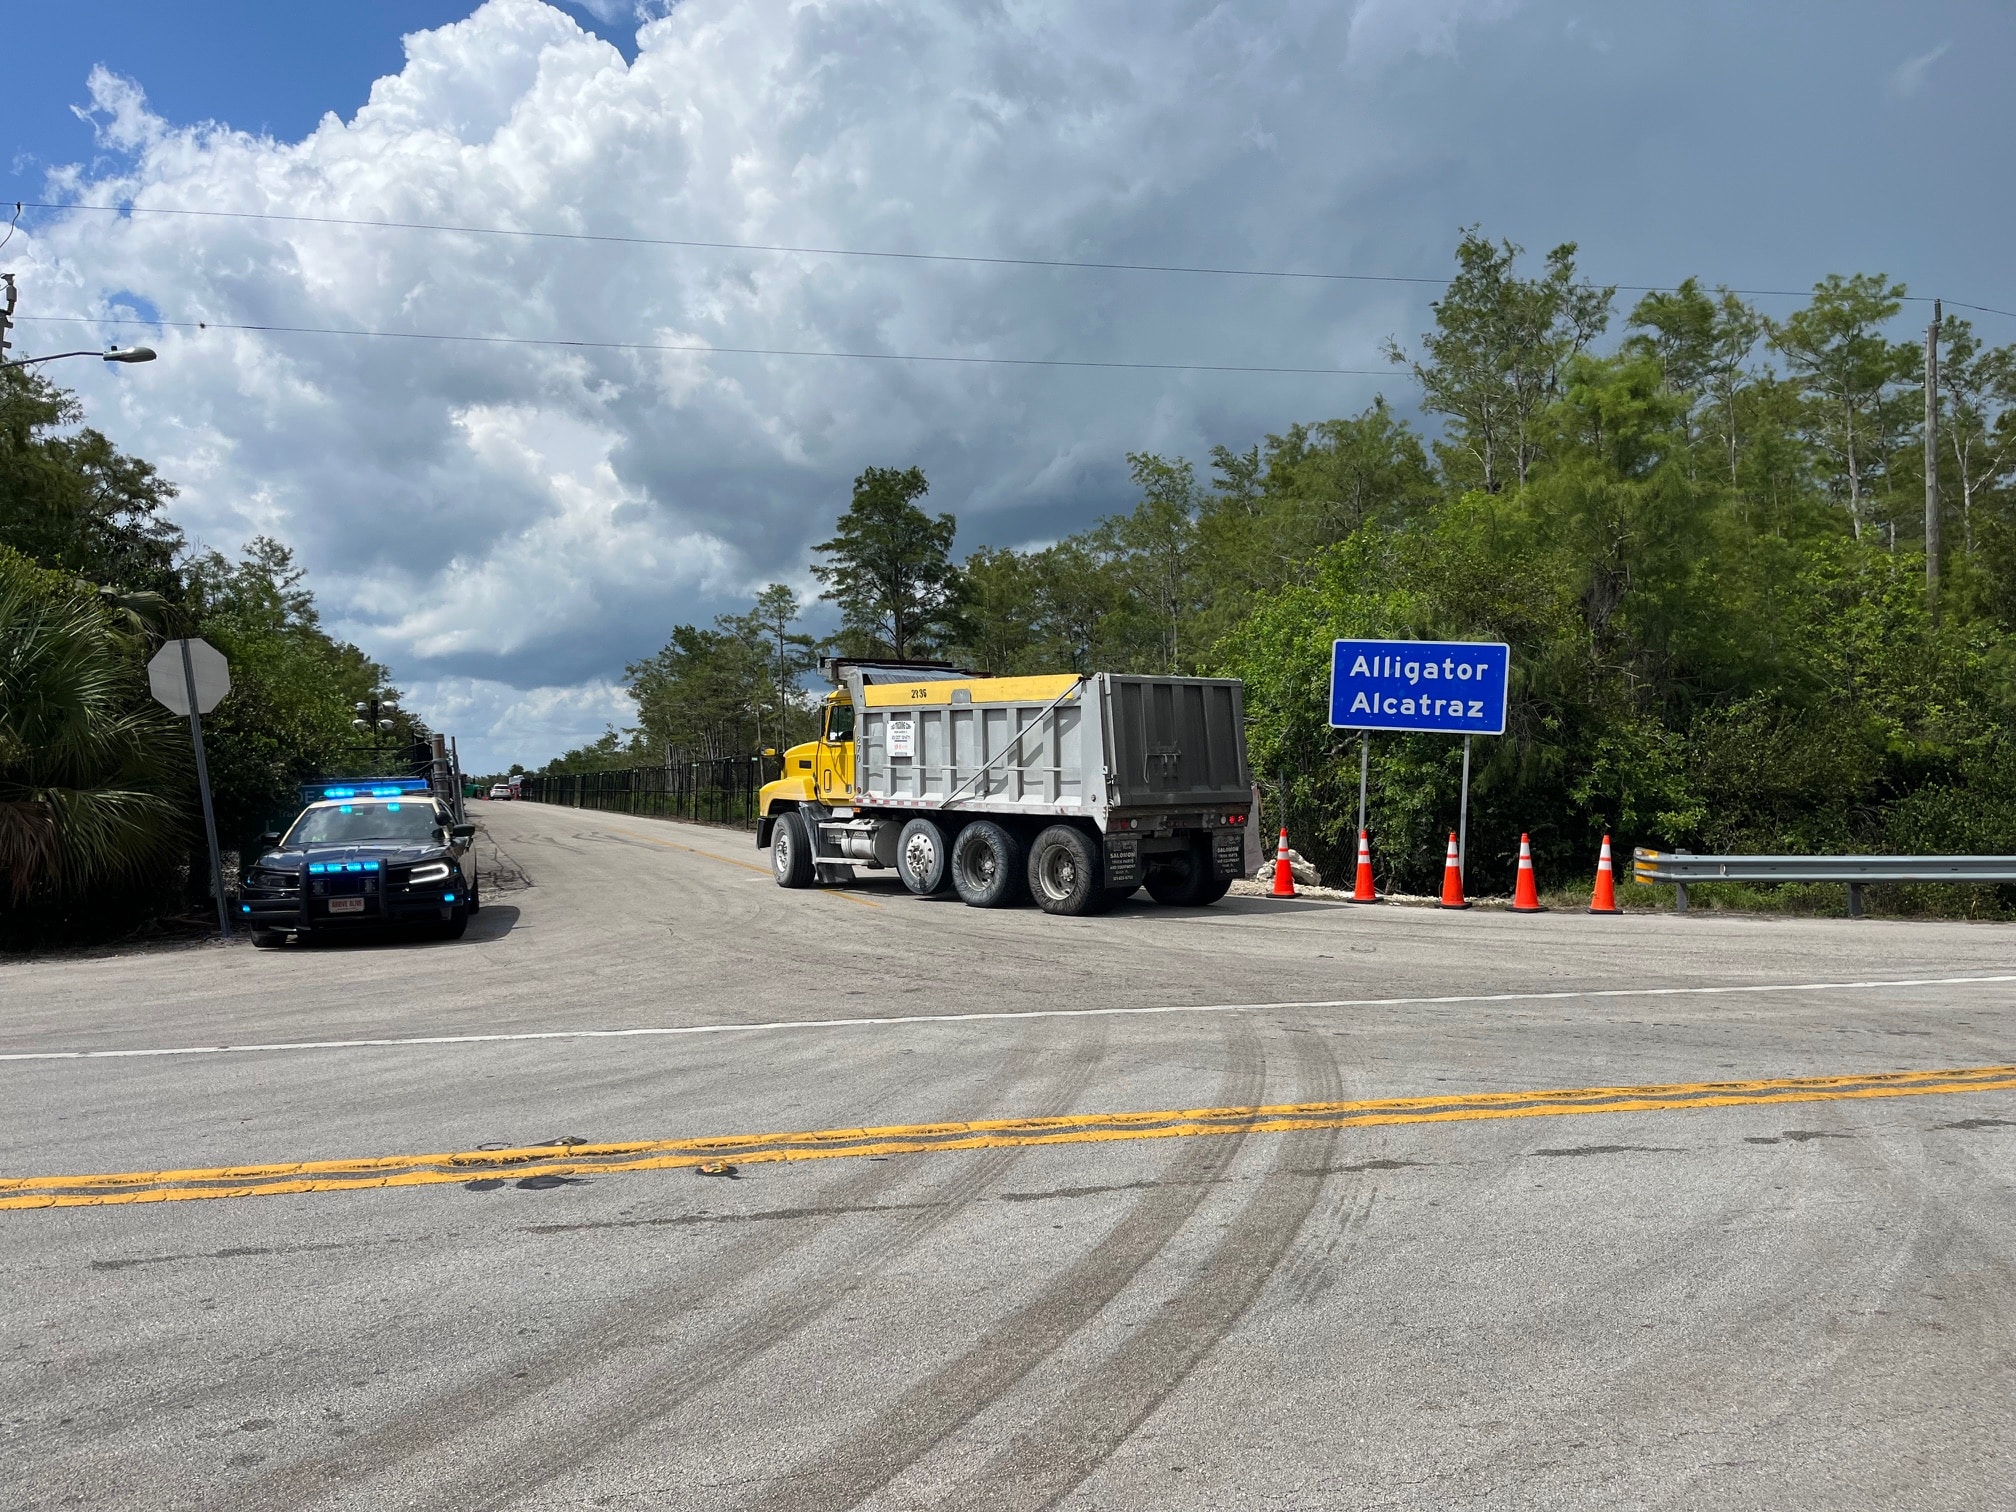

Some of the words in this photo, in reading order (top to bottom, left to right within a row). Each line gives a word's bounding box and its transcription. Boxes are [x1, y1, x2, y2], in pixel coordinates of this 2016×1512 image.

[1349, 655, 1489, 686] Alligator
[1349, 691, 1484, 718] Alcatraz
[332, 900, 348, 908] ARRIVE
[349, 899, 362, 907] ALIVE
